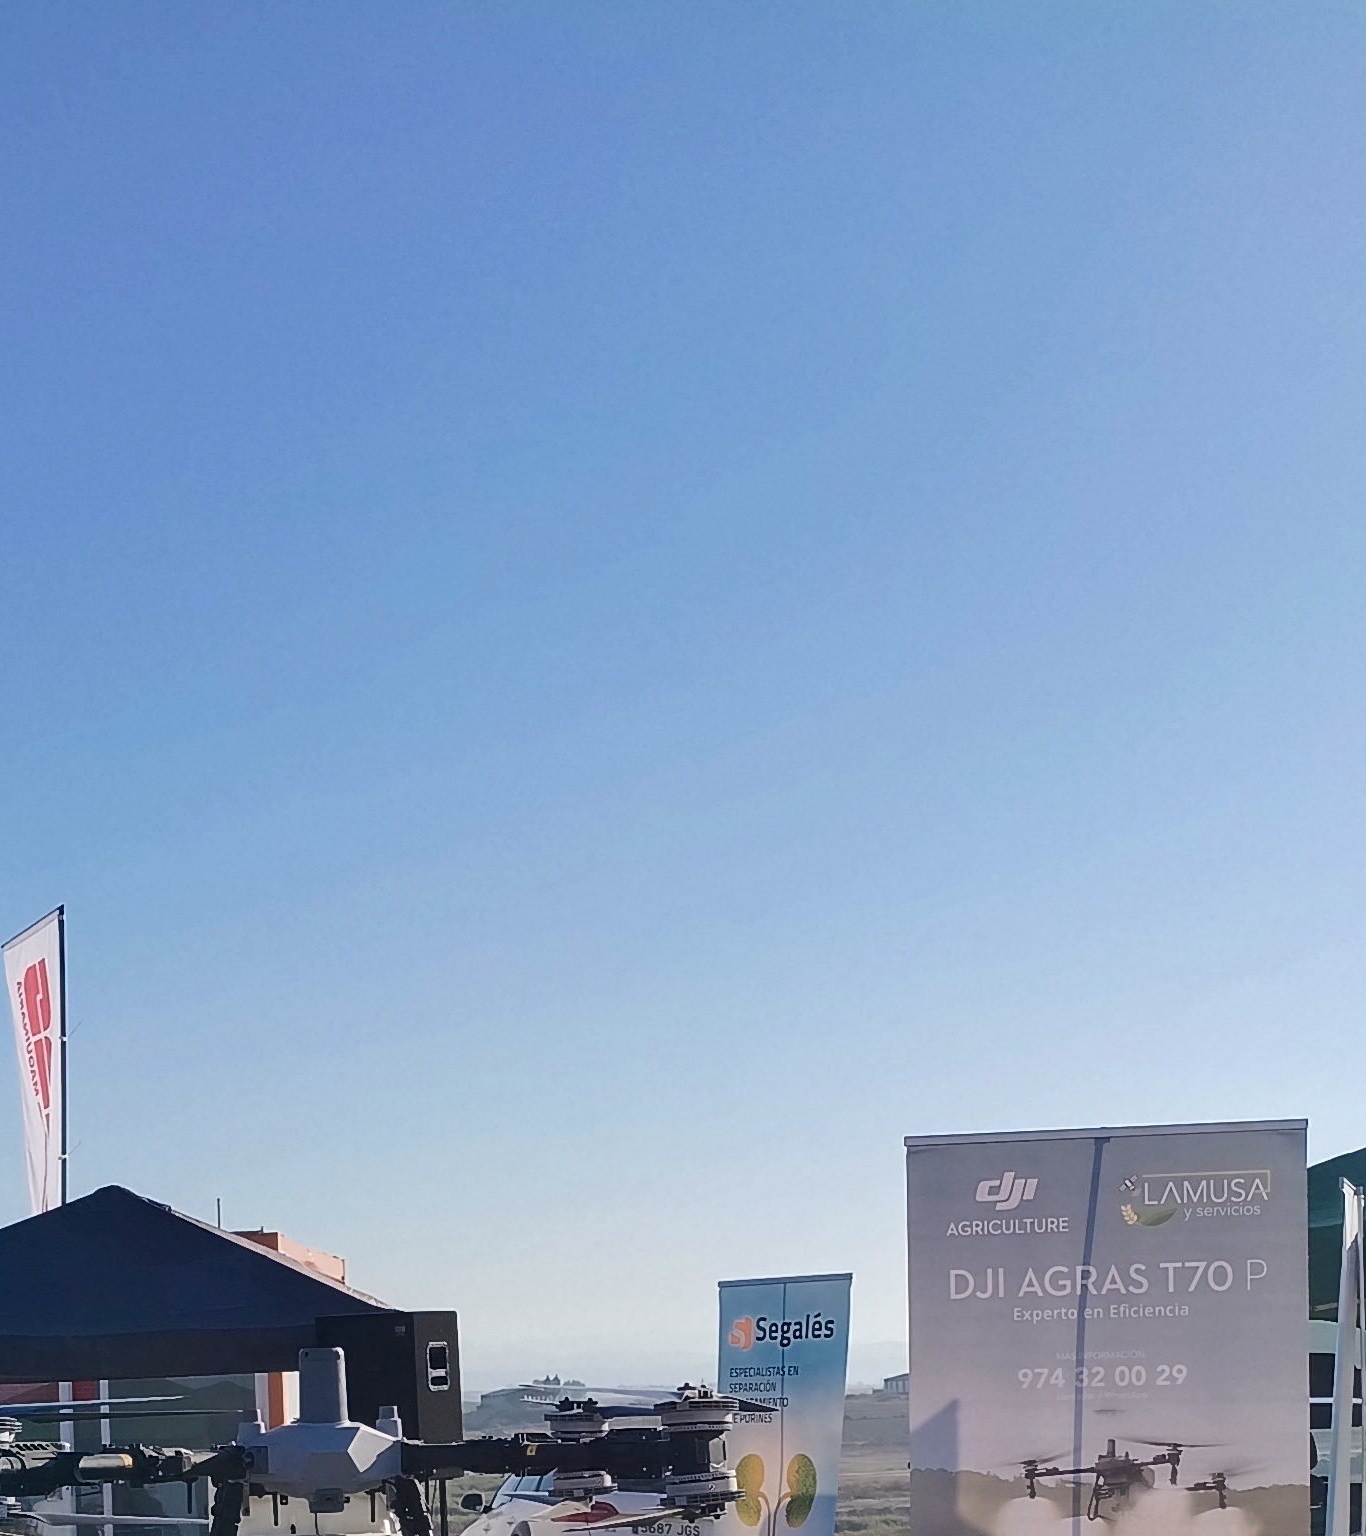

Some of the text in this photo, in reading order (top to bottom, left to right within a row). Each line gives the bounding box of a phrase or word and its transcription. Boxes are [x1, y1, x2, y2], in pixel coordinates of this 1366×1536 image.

[1144, 1178, 1269, 1206] LAMUSA
[1183, 1203, 1261, 1222] y servicios
[946, 1217, 1069, 1237] AGRICULTURE
[950, 1259, 1267, 1300] DJI AGRAS T70 P
[1013, 1303, 1189, 1324] Experto en Eficiencia
[755, 1313, 834, 1348] Segalés
[729, 1365, 799, 1377] ESPECIALISTAS EN
[1018, 1364, 1187, 1389] 974 32 00 29
[729, 1379, 777, 1393] SEPARACIÓN
[677, 1525, 700, 1536] JGS
